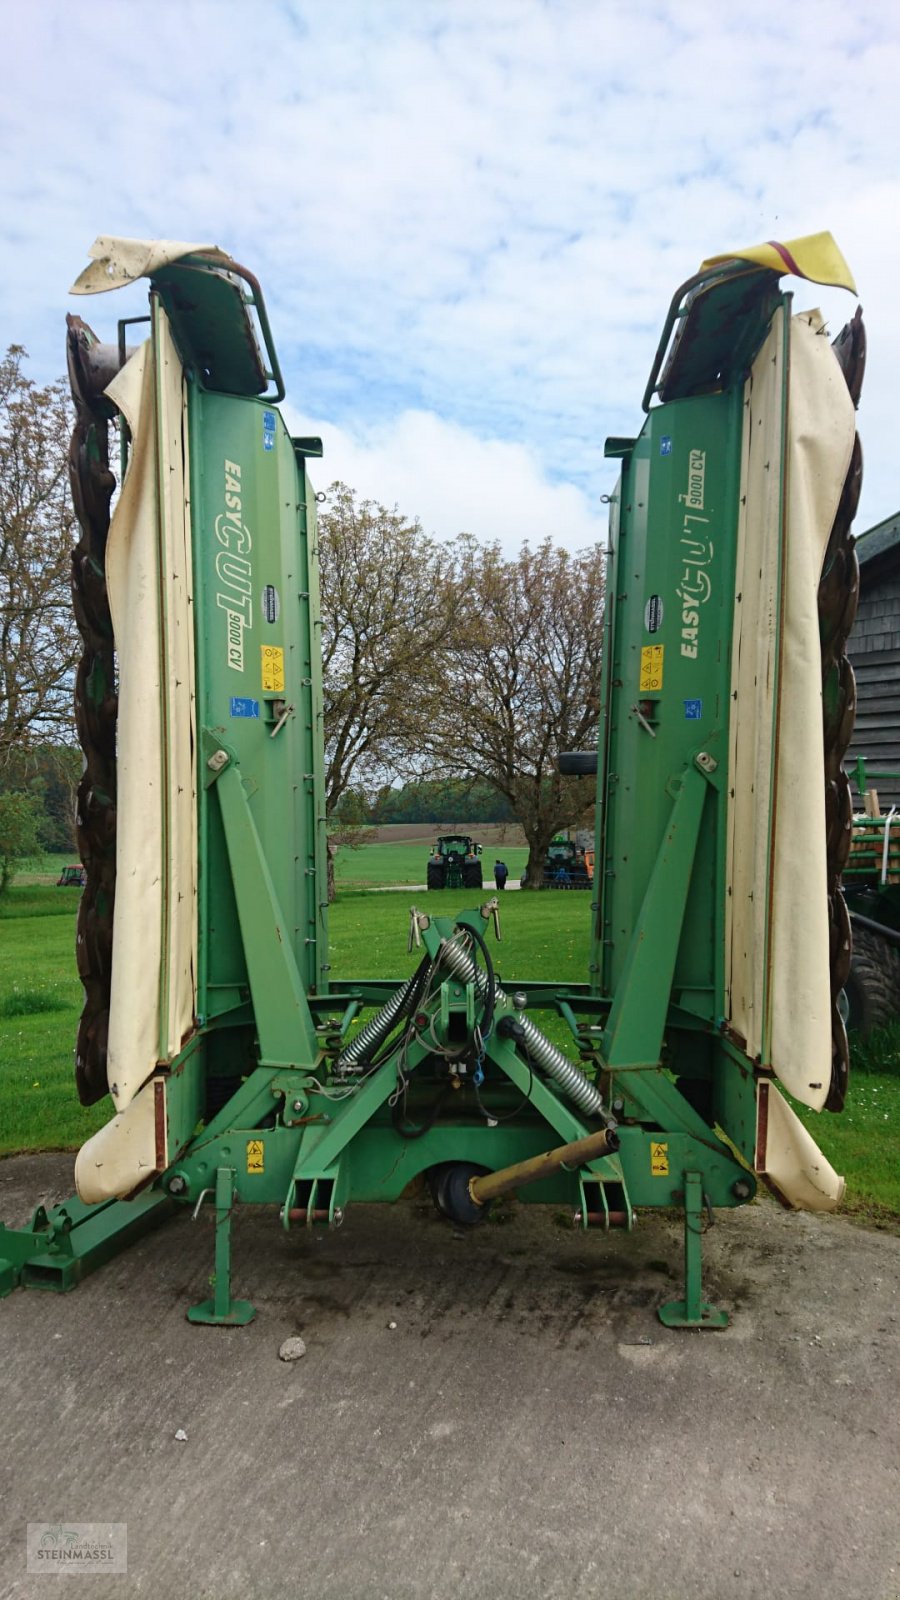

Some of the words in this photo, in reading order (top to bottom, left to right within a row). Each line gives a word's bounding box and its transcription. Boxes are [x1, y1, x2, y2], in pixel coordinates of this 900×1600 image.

[689, 452, 703, 471] CV
[689, 475, 703, 506] 9000
[229, 613, 241, 646] 9000
[229, 648, 242, 668] CV
